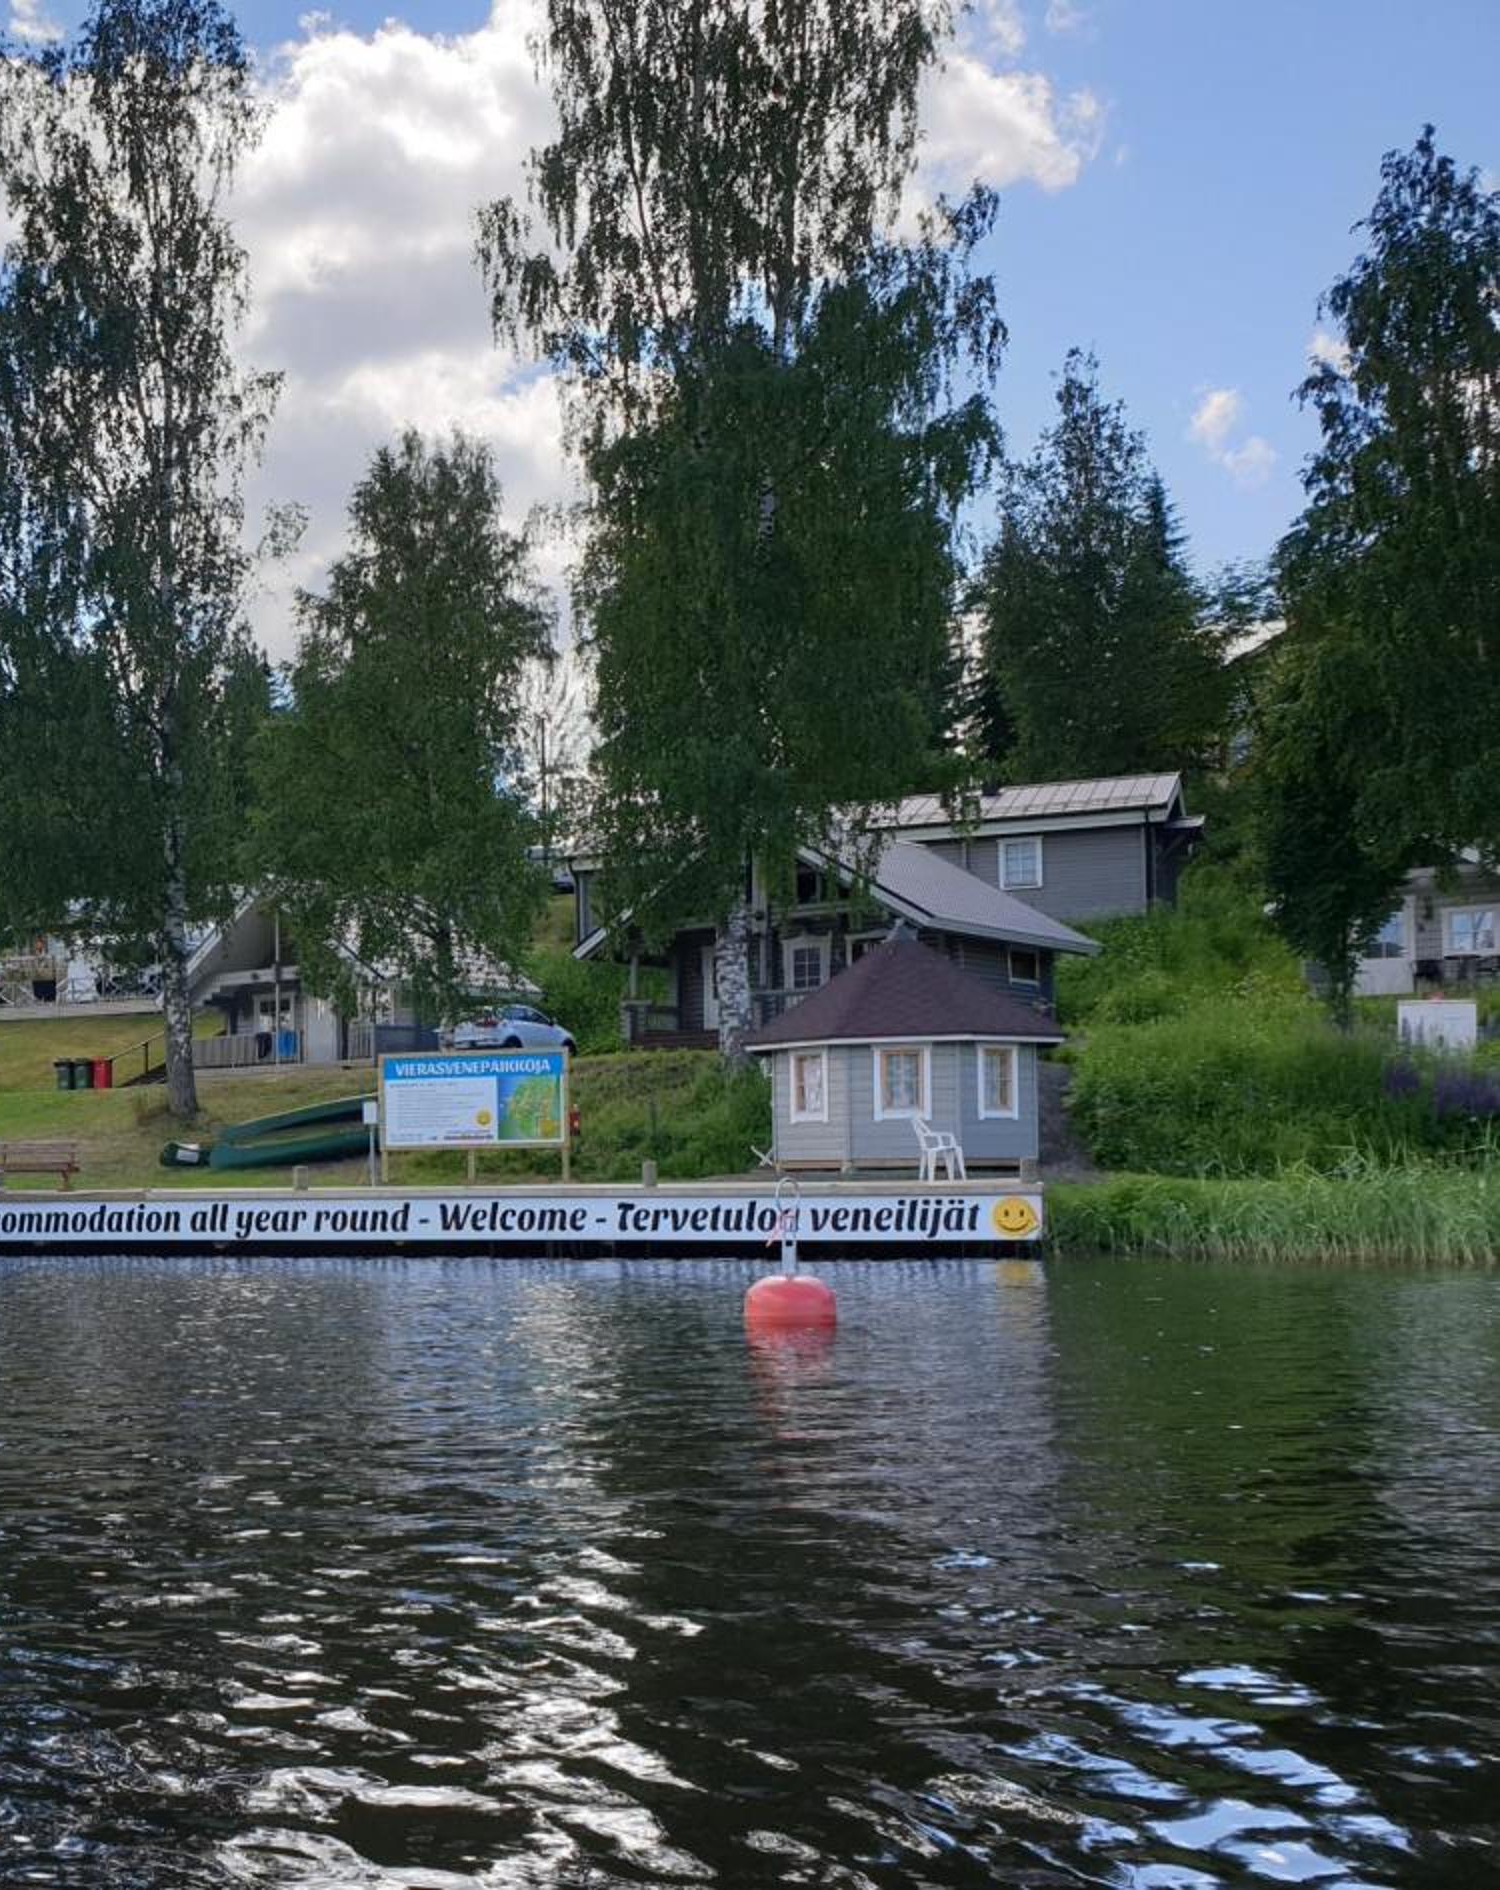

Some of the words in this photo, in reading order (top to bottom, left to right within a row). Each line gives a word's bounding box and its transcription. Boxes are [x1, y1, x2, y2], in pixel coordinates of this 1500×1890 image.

[395, 1059, 551, 1077] VIERASVENEPAIKKOJA
[190, 1203, 228, 1233] all
[235, 1210, 307, 1239] year
[313, 1203, 411, 1233] round
[439, 1203, 587, 1232] Welcome
[810, 1202, 980, 1239] veneilijät
